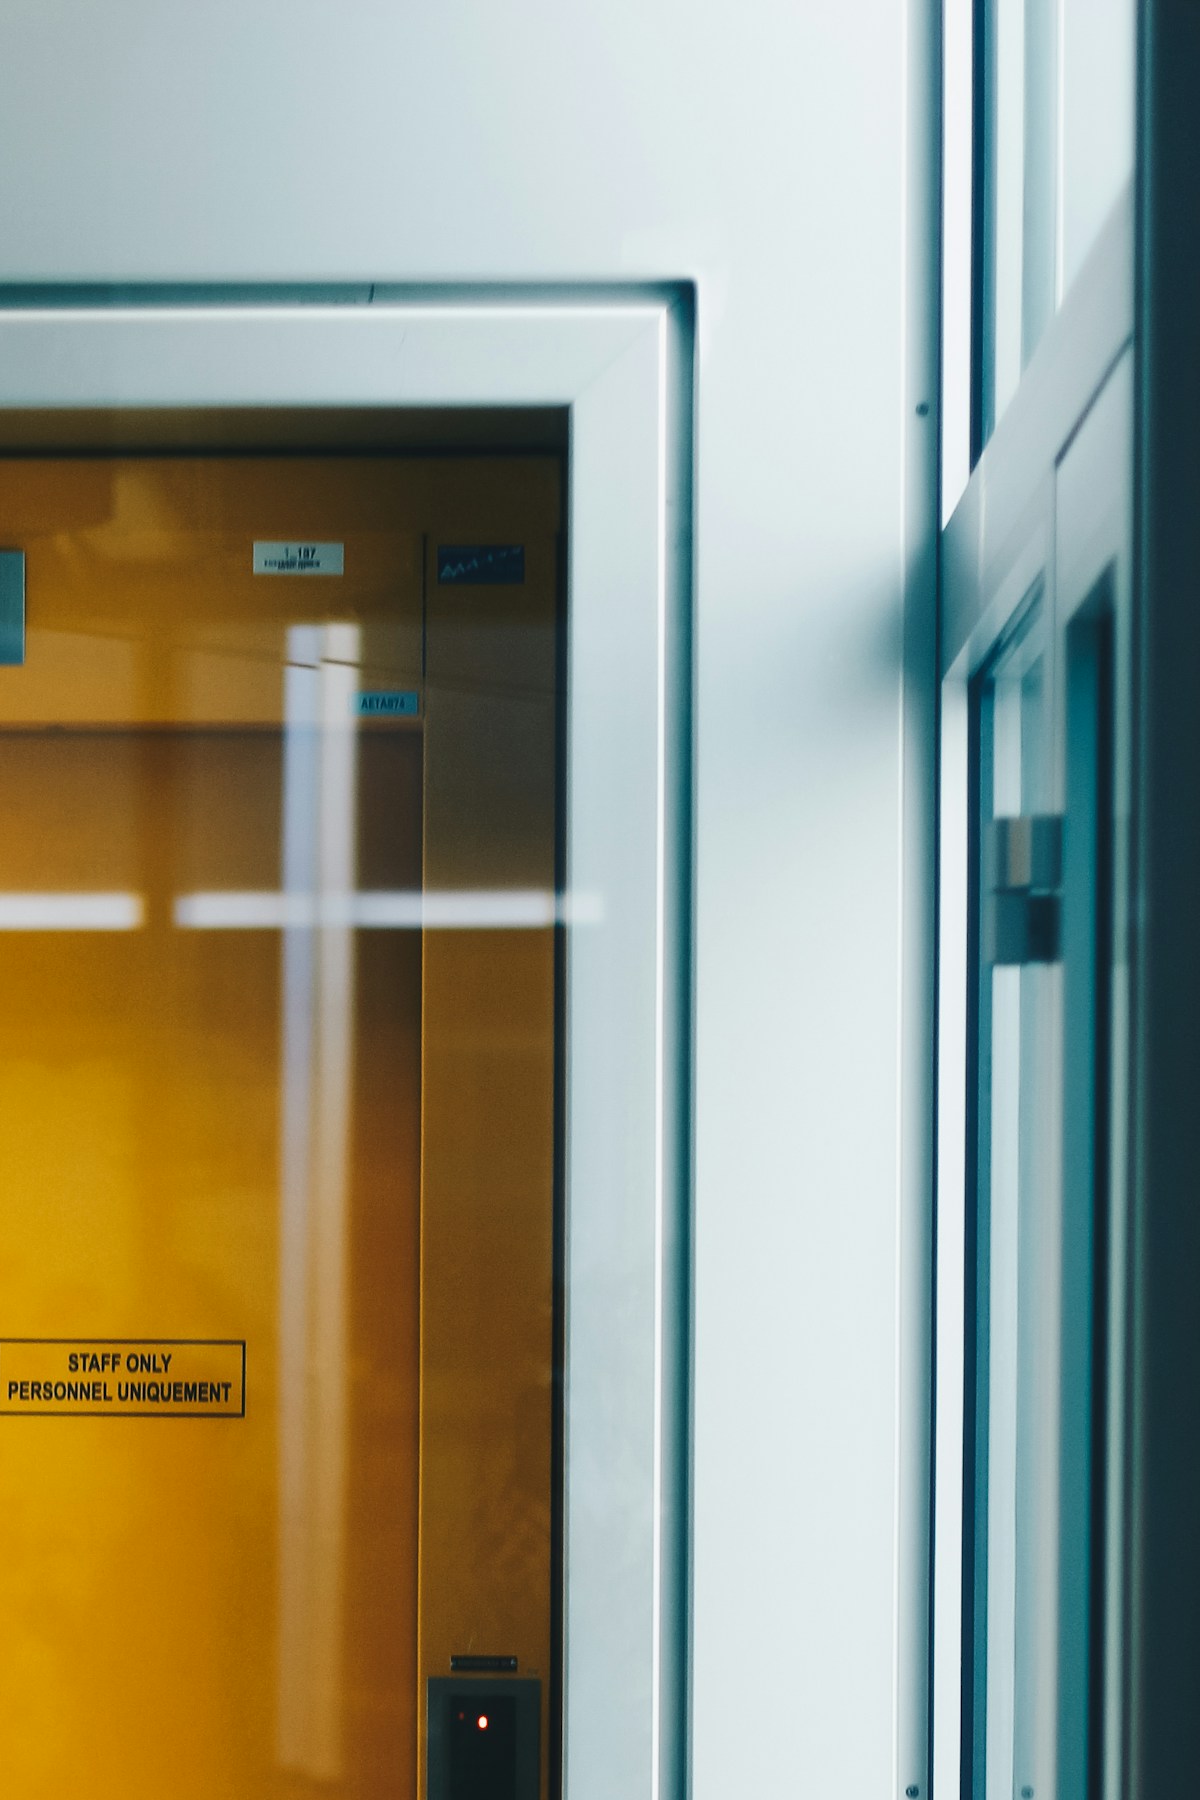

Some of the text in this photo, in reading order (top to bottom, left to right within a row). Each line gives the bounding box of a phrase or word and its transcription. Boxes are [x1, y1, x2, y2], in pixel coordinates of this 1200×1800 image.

[68, 1353, 172, 1374] STAFF ONLY
[7, 1381, 232, 1404] PERSONNEL UNIQUEMENT
